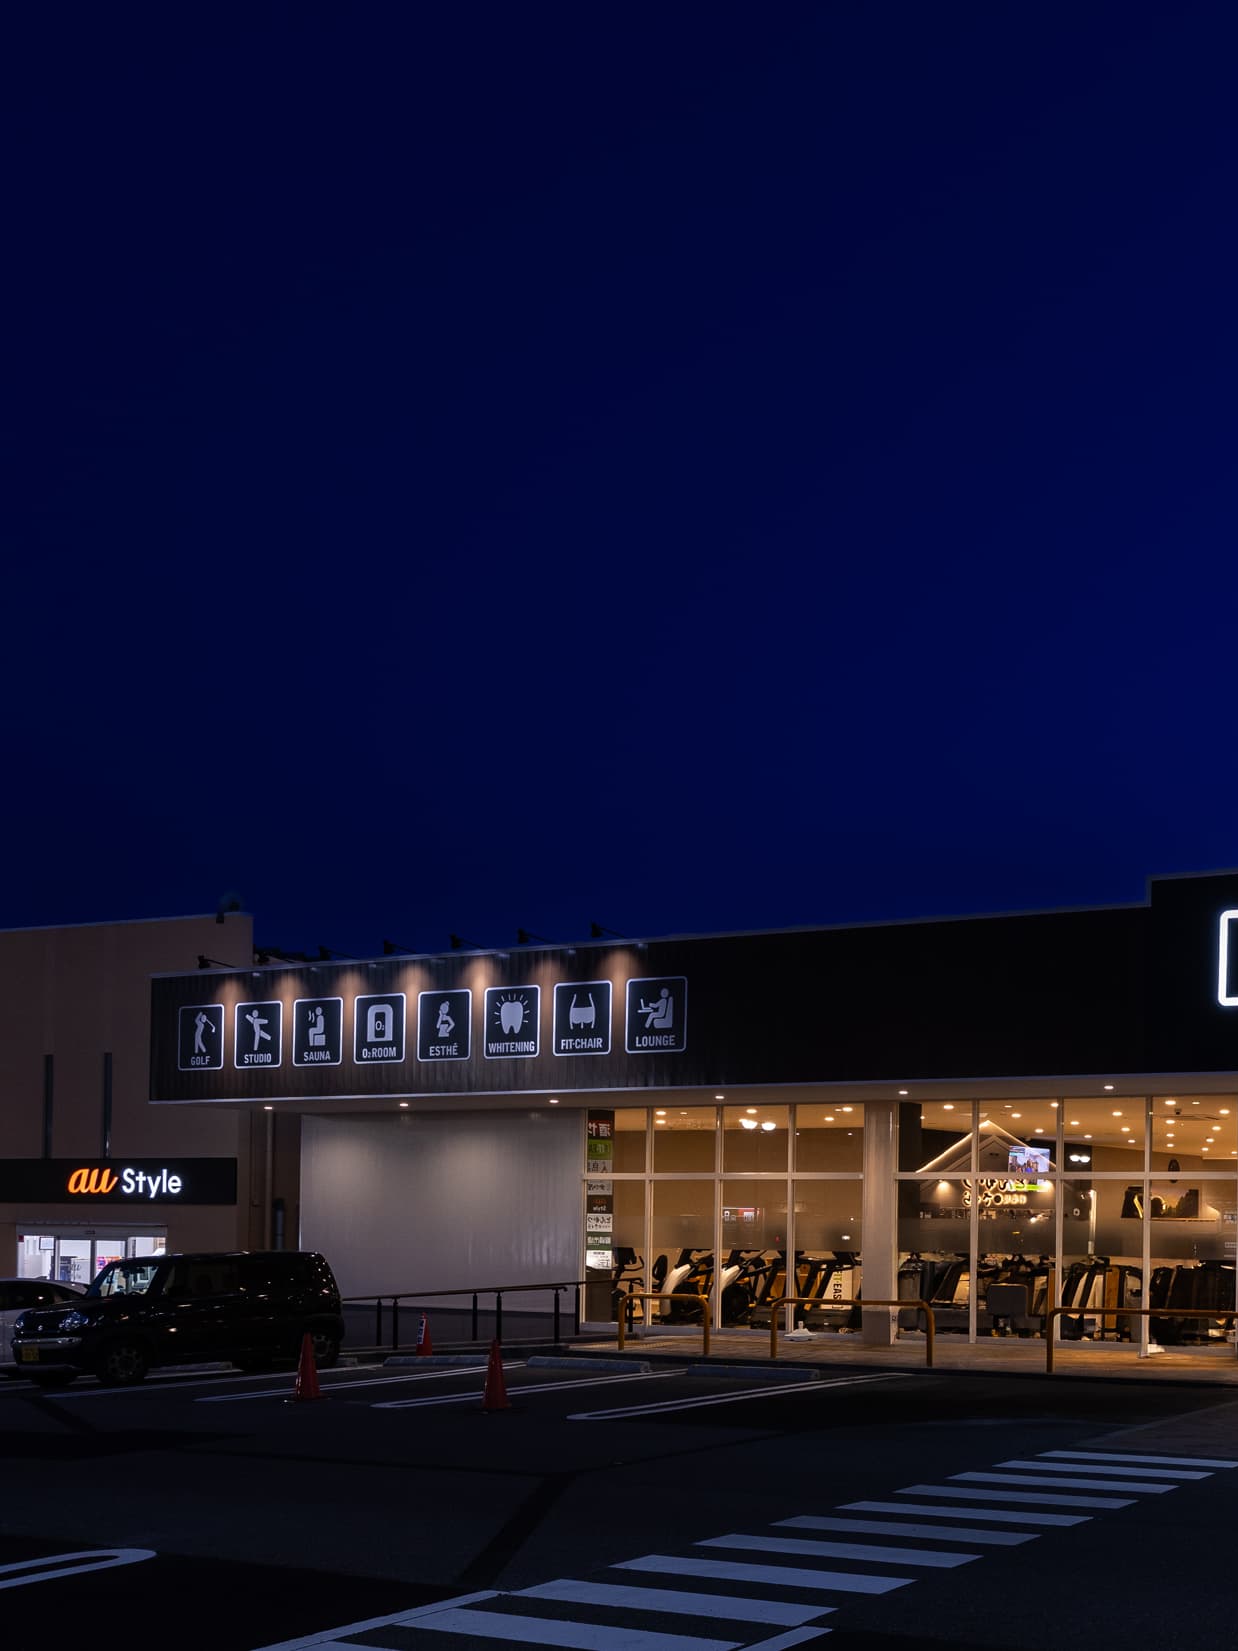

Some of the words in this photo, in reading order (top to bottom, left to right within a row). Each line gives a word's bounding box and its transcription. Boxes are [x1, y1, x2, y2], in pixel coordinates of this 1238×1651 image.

[488, 1040, 535, 1054] WHITENING
[635, 1034, 676, 1047] LOUNGE
[429, 1042, 459, 1057] ESTHÉ
[190, 1055, 211, 1066] GOLF
[244, 1053, 272, 1064] STUDIO
[303, 1051, 331, 1062] SAUNA
[67, 1168, 119, 1194] au
[121, 1168, 182, 1199] Style
